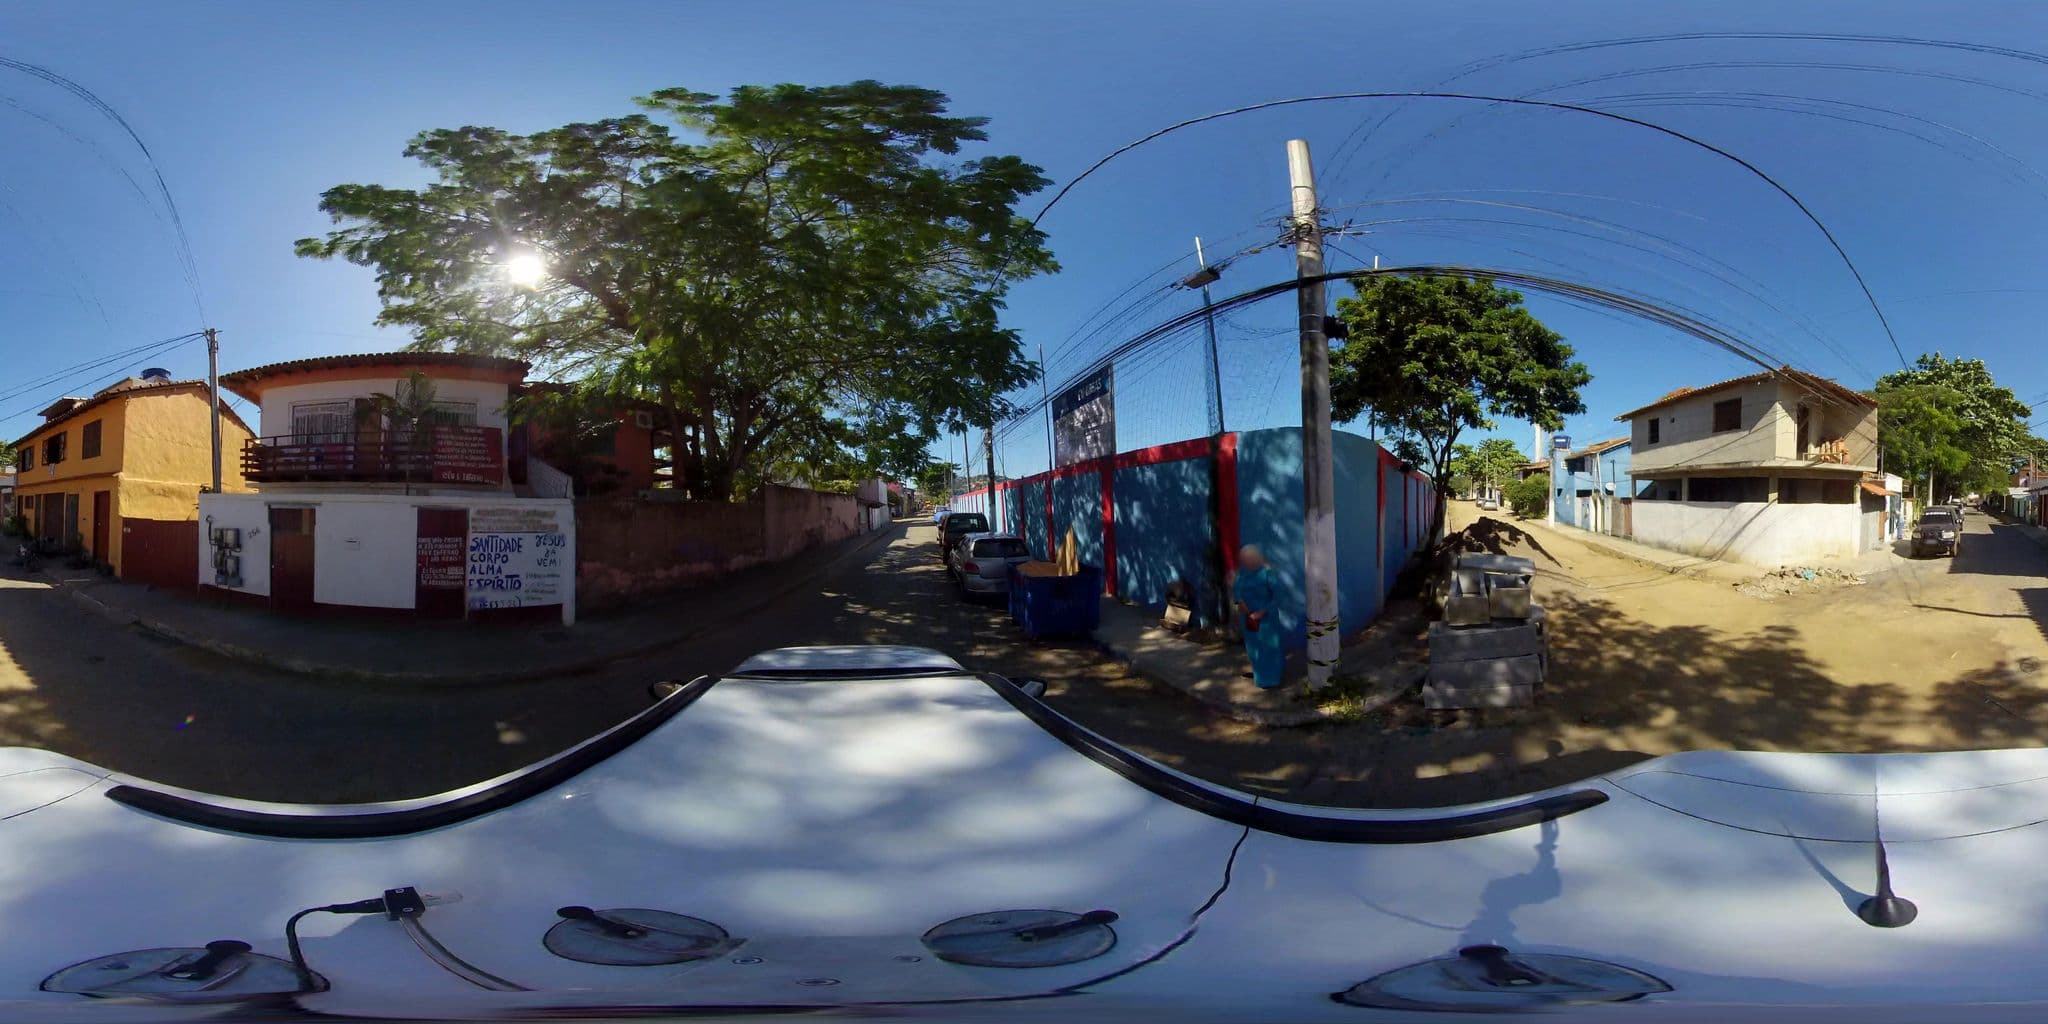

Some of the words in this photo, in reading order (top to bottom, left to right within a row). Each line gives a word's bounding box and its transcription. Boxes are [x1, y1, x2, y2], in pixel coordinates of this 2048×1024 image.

[470, 535, 523, 553] SANTIDADE
[470, 553, 509, 564] CORPO
[469, 564, 503, 575] ALMA
[468, 575, 522, 591] ESPÍRITO
